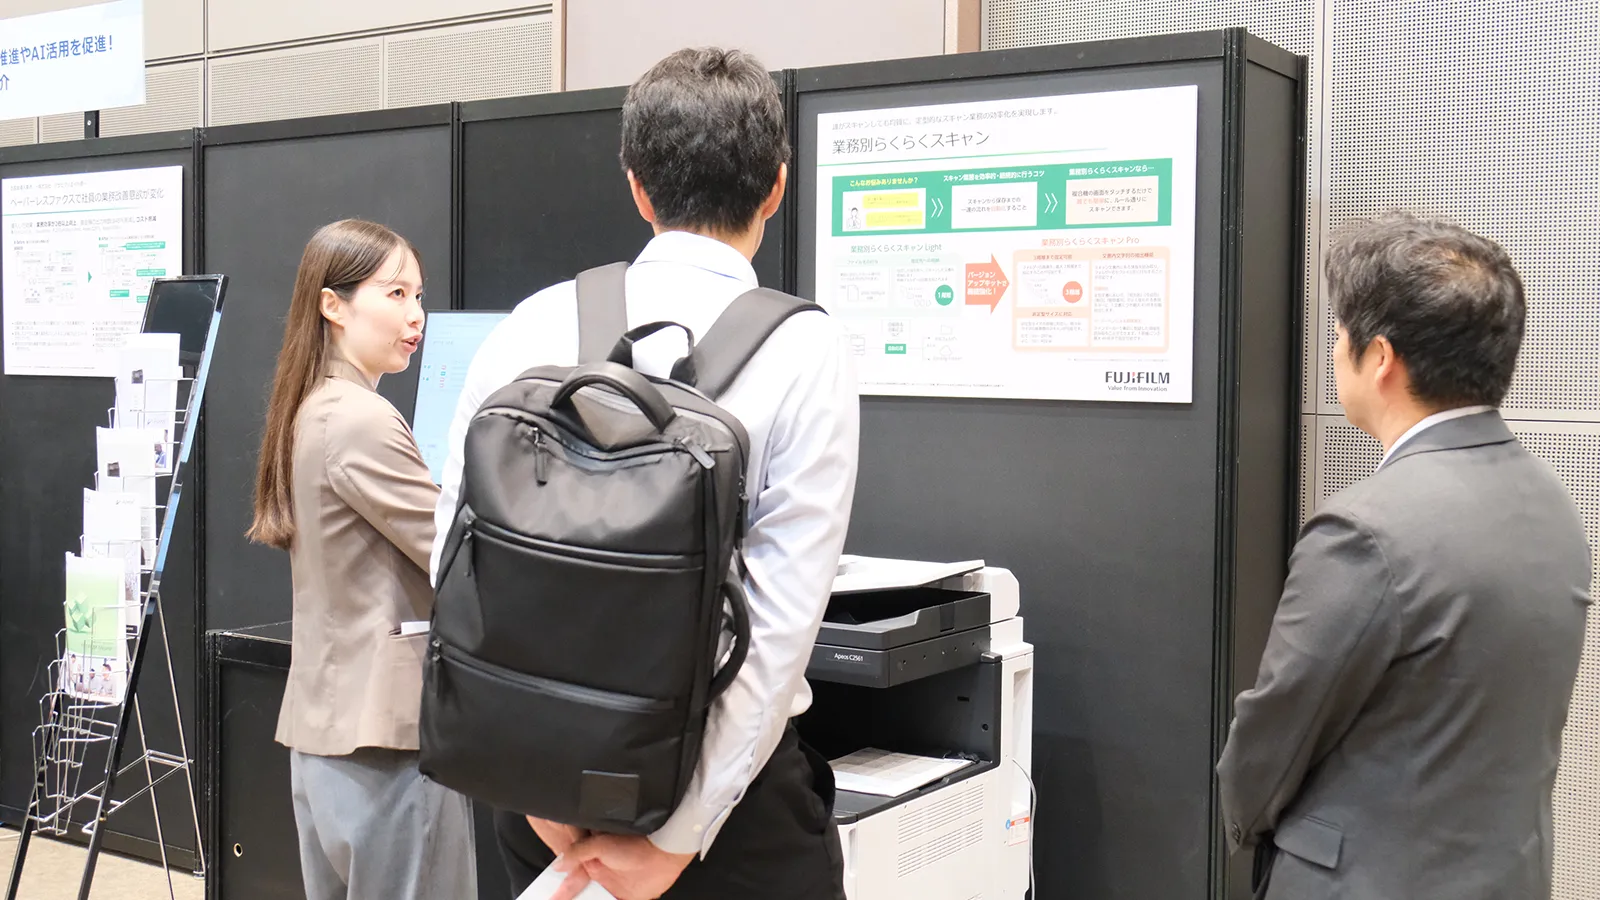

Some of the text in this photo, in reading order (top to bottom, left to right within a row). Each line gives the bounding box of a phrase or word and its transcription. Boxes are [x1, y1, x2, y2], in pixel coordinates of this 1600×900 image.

[832, 131, 990, 154] 業務別らくらくスキャン
[1126, 236, 1140, 245] Pro
[924, 243, 942, 253] Light
[967, 271, 996, 279] バージョン
[1105, 371, 1170, 384] FUJIFILM
